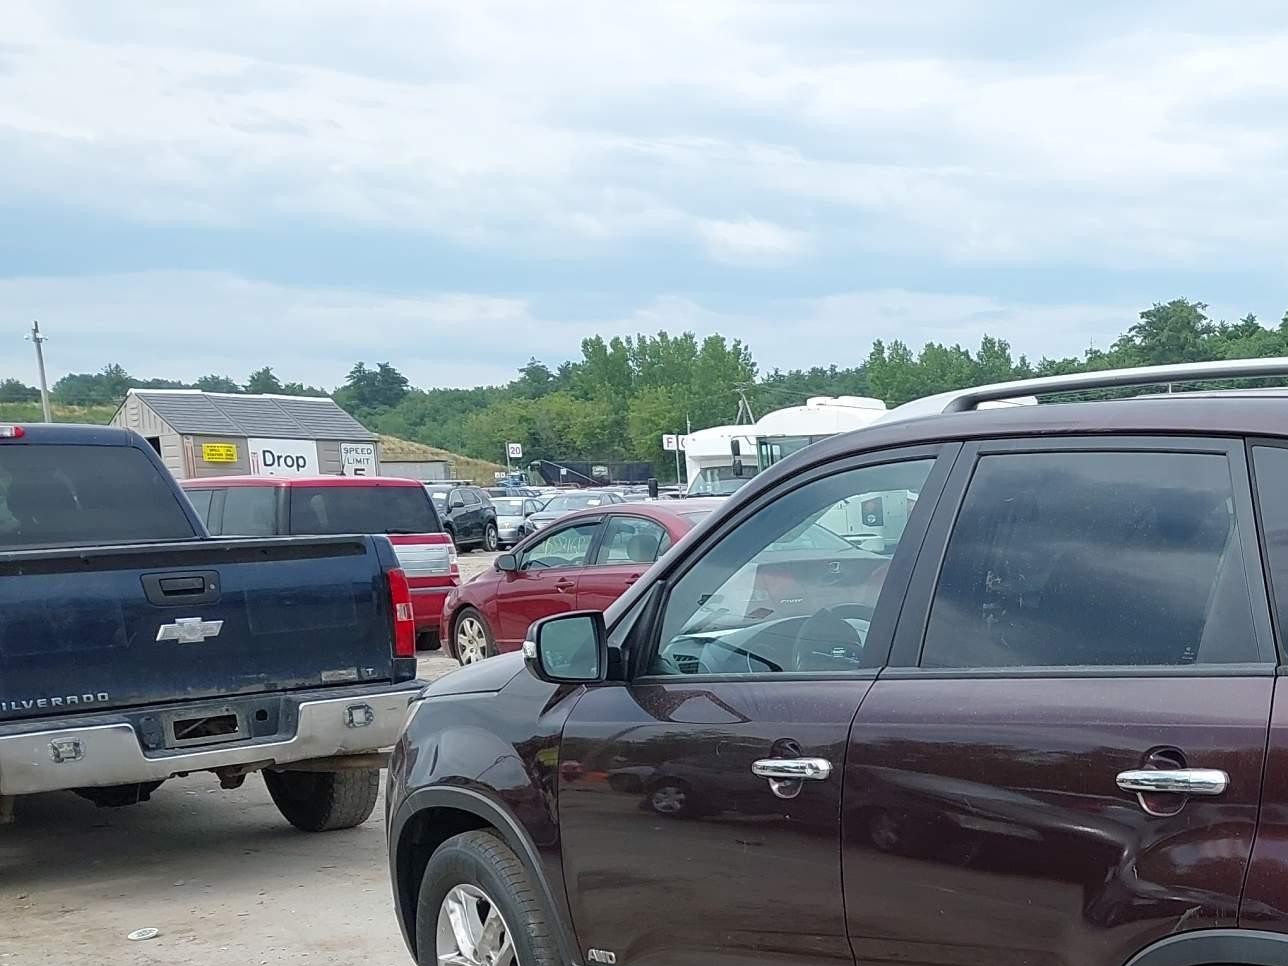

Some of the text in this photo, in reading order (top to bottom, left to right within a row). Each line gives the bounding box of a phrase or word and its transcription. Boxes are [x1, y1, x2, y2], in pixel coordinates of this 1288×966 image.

[666, 436, 673, 448] F
[510, 446, 521, 455] 20
[262, 449, 307, 472] Drop
[346, 457, 370, 465] LIMIT
[0, 692, 109, 711] ILVERADO
[587, 948, 617, 965] AWD
